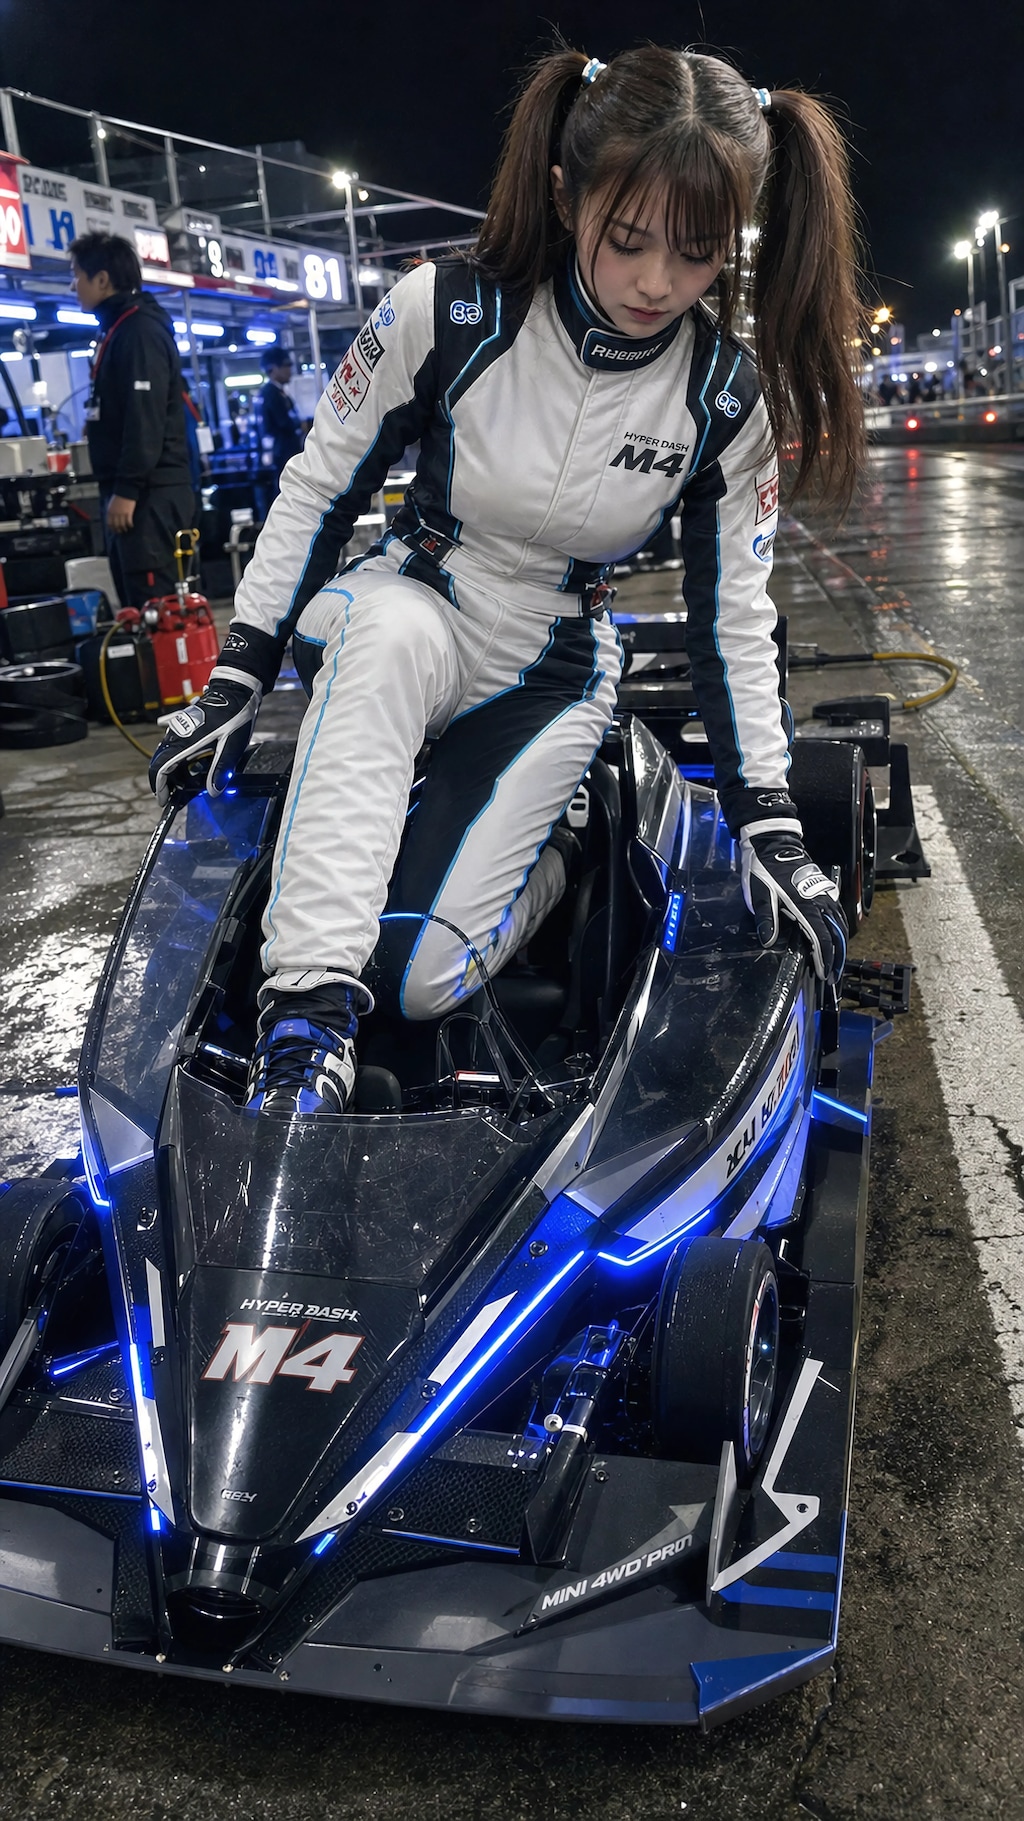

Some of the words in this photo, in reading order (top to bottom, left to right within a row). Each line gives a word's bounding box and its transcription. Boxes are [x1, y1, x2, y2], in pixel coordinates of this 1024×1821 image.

[303, 254, 342, 301] 81
[608, 443, 686, 479] M4
[624, 431, 660, 447] HYPER
[660, 440, 690, 453] DASH
[240, 1299, 303, 1318] HYPER
[304, 1304, 359, 1322] DASH
[200, 1321, 366, 1394] M4
[541, 1579, 588, 1610] MINI
[591, 1557, 642, 1589] 4WD
